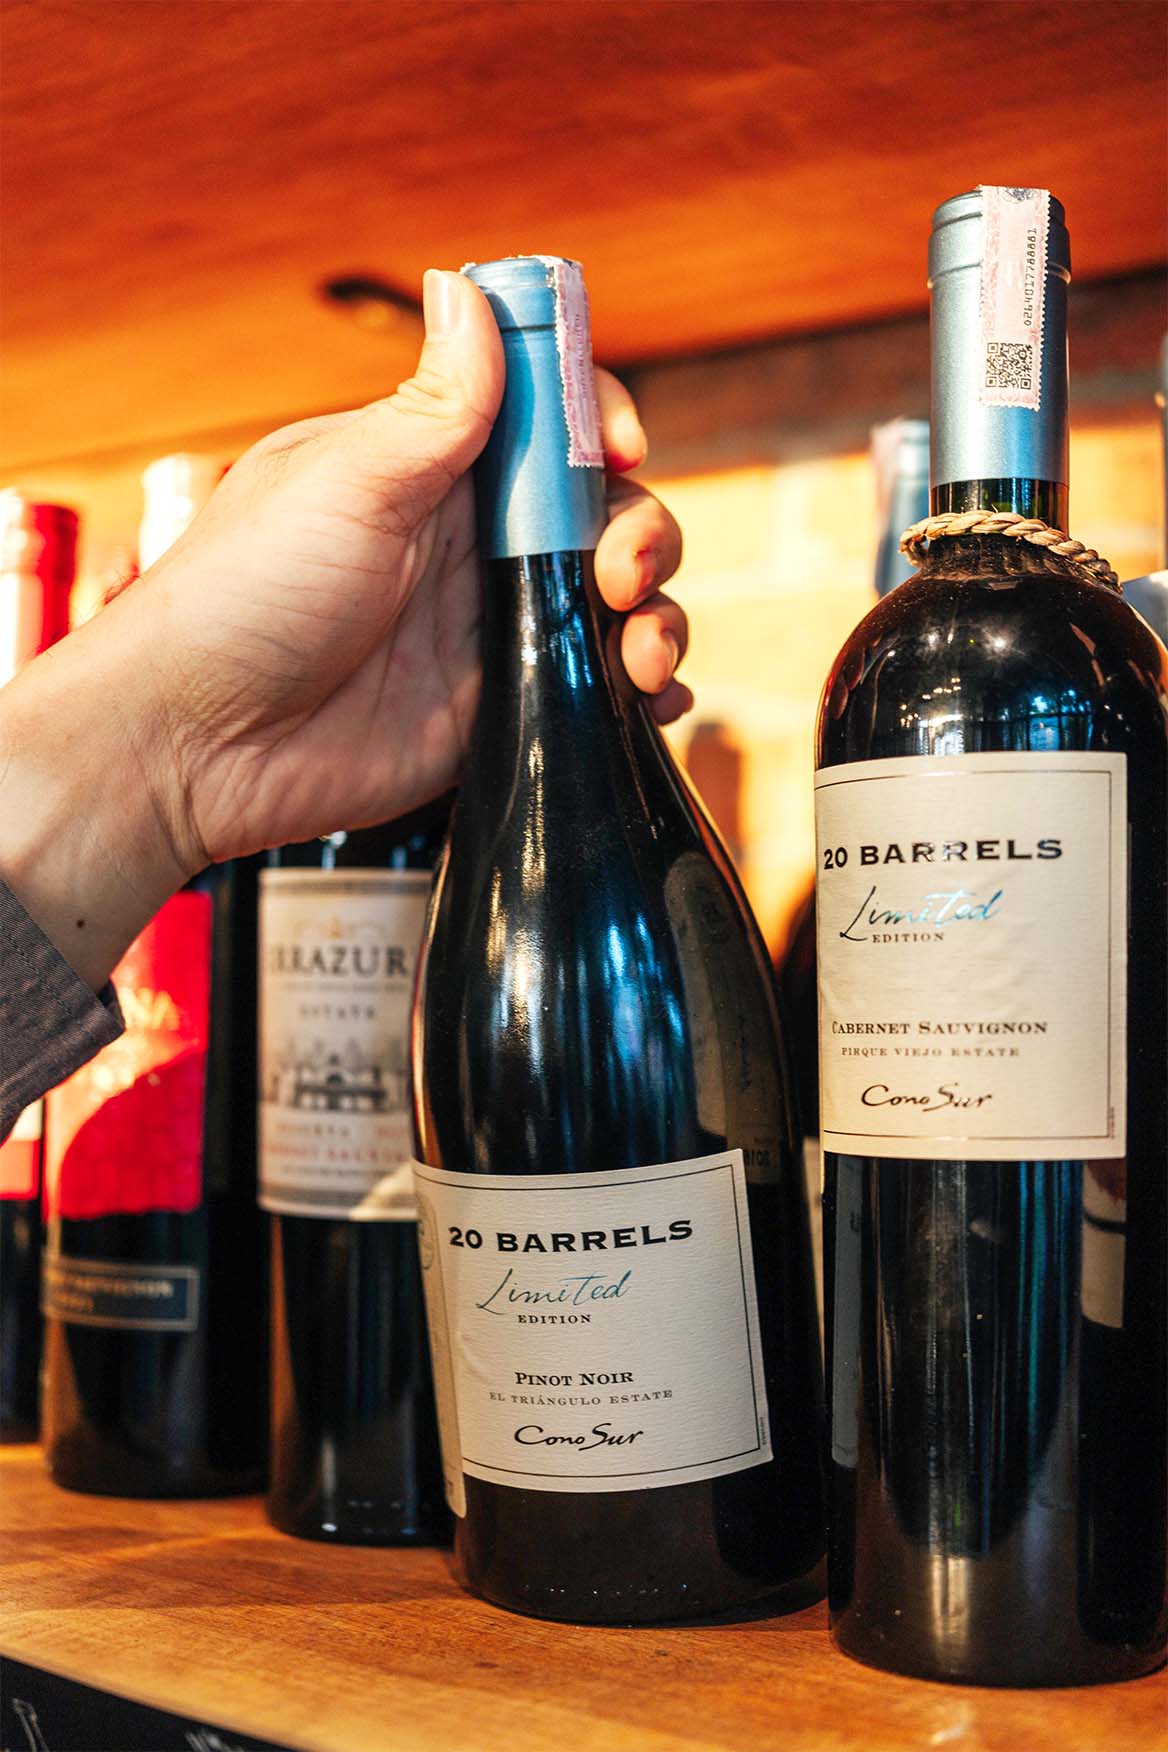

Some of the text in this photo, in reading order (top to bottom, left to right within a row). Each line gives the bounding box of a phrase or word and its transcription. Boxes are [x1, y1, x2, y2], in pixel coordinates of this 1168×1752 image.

[823, 839, 1063, 870] 20 BARRELS
[839, 885, 1004, 941] Limited
[872, 932, 945, 944] EDITION
[832, 1020, 1048, 1035] CABERNET SAUVIGNON
[841, 1046, 1020, 1058] PIRQUE VIEJO ESTATE
[861, 1082, 993, 1112] Cono Sur
[448, 1219, 693, 1253] 20 BARRELS
[475, 1268, 632, 1315] Limited
[517, 1313, 592, 1325] EDITION
[514, 1371, 634, 1387] PINOT NOIR
[489, 1389, 674, 1407] EL TRIÁNGULO ESTATE
[514, 1422, 645, 1451] Cono Sur
